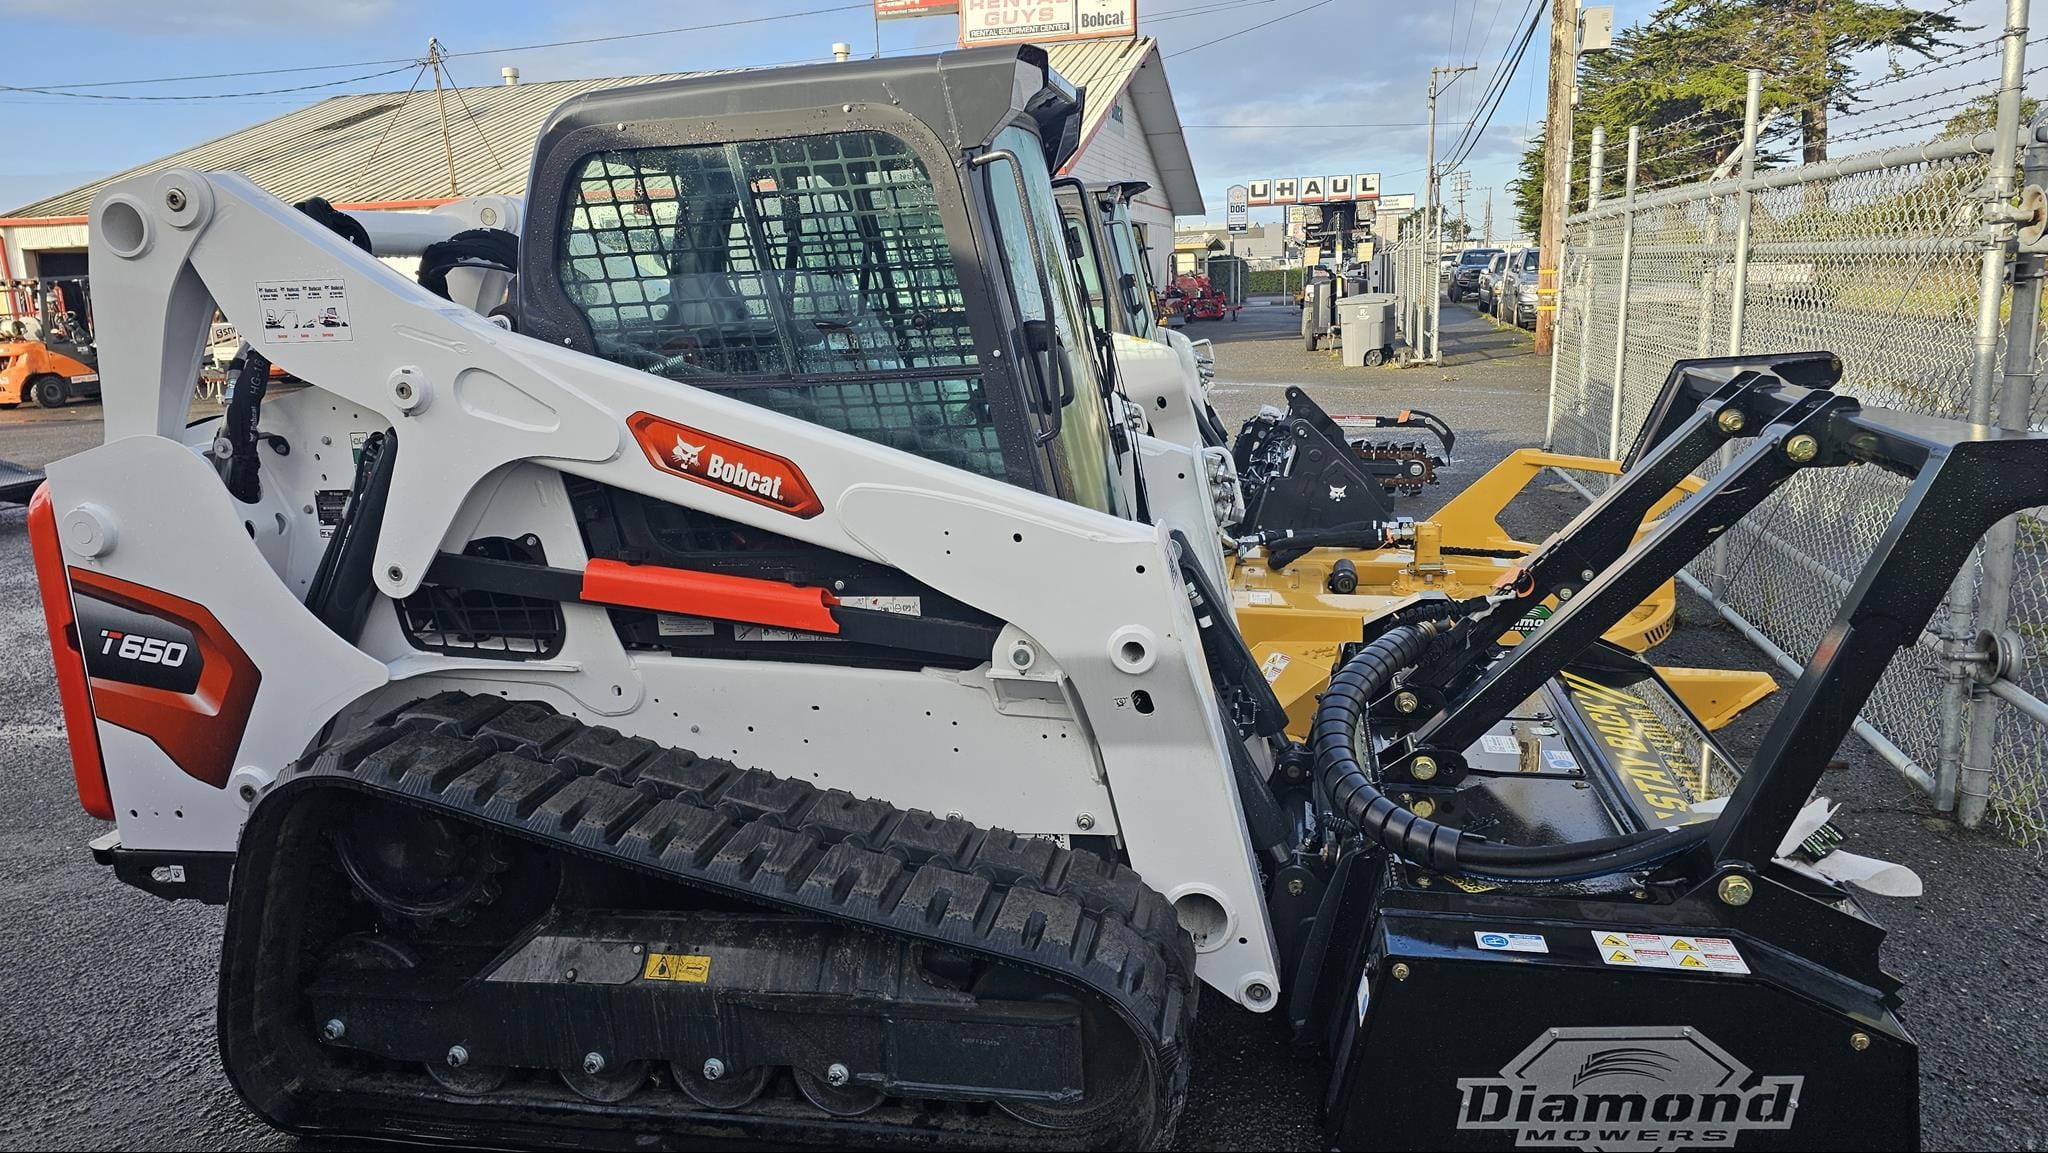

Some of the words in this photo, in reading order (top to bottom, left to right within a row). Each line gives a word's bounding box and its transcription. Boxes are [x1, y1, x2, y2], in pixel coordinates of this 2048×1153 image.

[970, 0, 1069, 10] RENTAL
[984, 7, 1054, 26] GUYS
[1081, 10, 1125, 28] Bobcat
[971, 28, 999, 38] RENTAL
[1000, 25, 1038, 36] EQUIPMENT
[1040, 22, 1069, 33] CENTER
[1230, 205, 1246, 213] DOG
[707, 453, 781, 499] Bobcat
[101, 630, 188, 667] T650
[1580, 700, 1649, 753] BACK
[1615, 752, 1689, 812] STAY
[1466, 1083, 1794, 1123] Diamond
[1524, 1129, 1729, 1142] MOWERS
